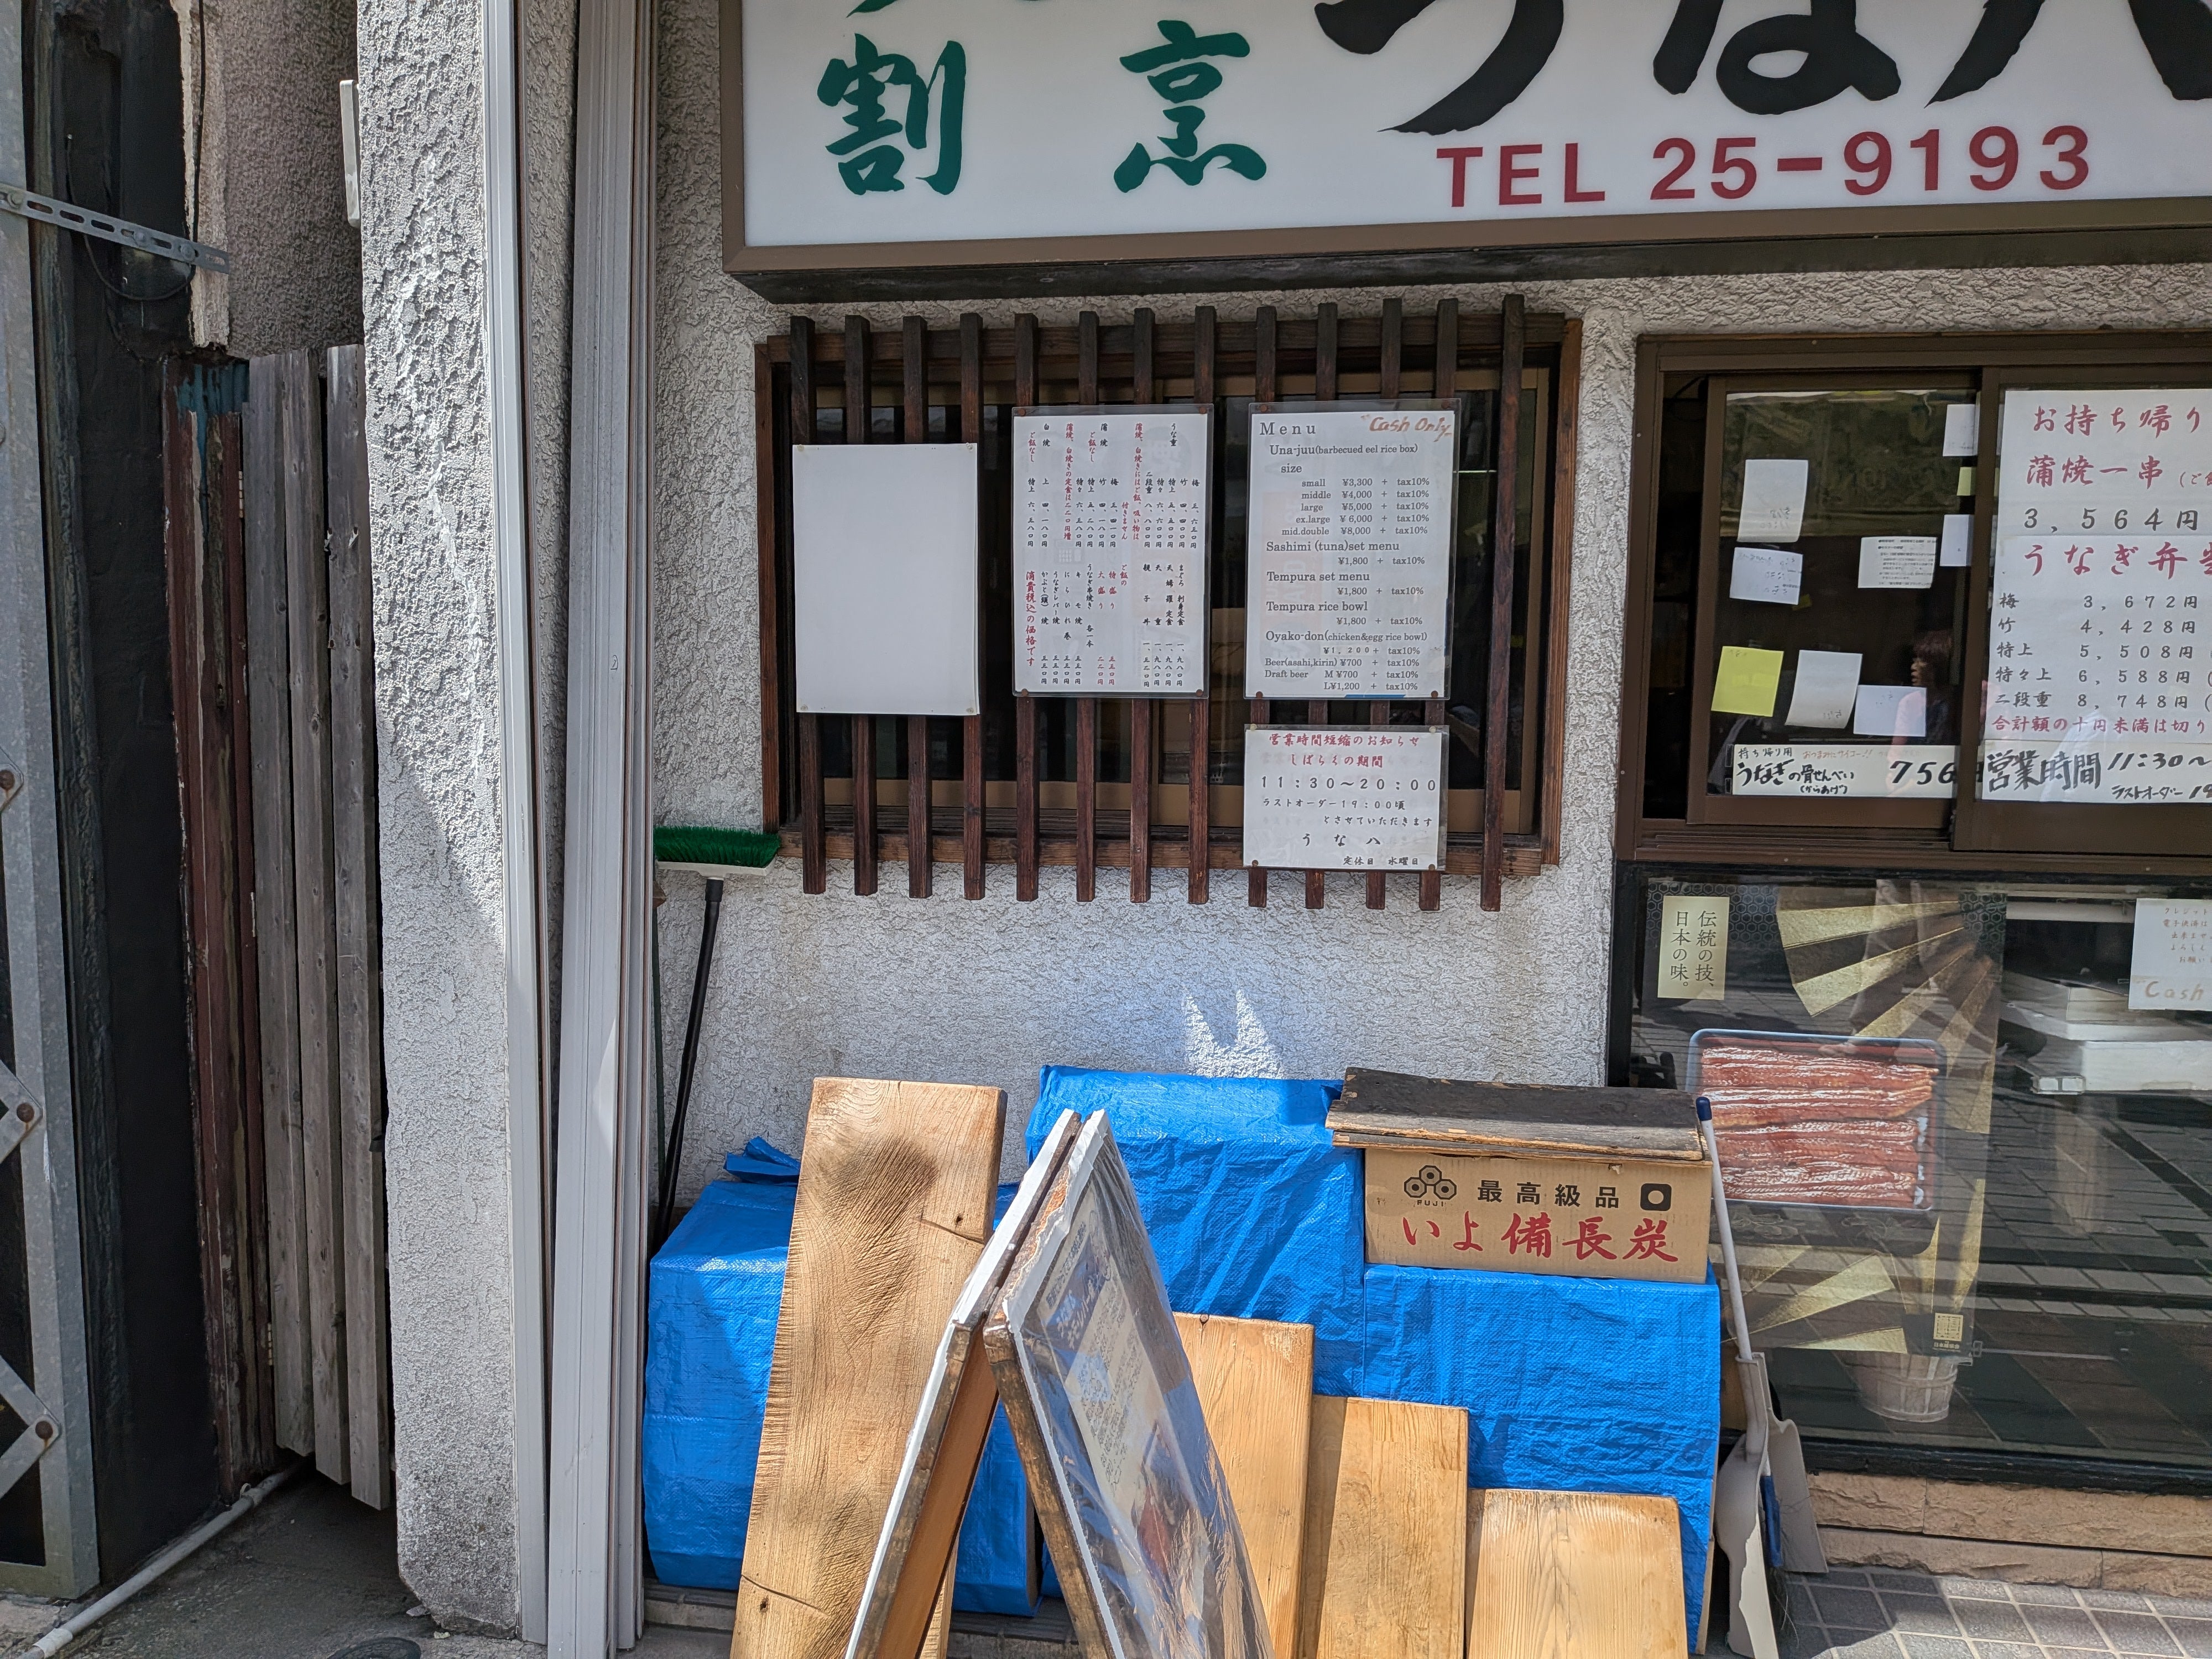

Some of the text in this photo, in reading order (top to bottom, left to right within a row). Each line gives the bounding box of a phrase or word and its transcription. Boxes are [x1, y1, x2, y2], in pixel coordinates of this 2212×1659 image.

[1436, 125, 2090, 208] TEL 25-9193
[2033, 404, 2200, 439] お持ち帰り
[1042, 423, 1051, 447] 白焼
[1169, 423, 1178, 447] うな重
[1259, 422, 1316, 435] Menu
[1365, 445, 1378, 453] eel
[1380, 445, 1397, 453] rice
[1281, 462, 1302, 473] size
[2027, 454, 2163, 489] 蒲焼一串
[1027, 477, 1036, 493] 特上
[1087, 477, 1095, 493] 特上
[1099, 477, 1107, 486] 竹
[1110, 478, 1119, 486] 梅
[1145, 471, 1153, 494] 二段重
[1168, 477, 1176, 493] 特上
[1180, 478, 1188, 487] 竹
[1191, 478, 1201, 487] 梅
[1301, 478, 1326, 487] small
[1397, 477, 1430, 486] tax10%
[1301, 491, 1332, 499] middle
[1301, 503, 1323, 513] large
[1396, 502, 1429, 510] tax10%
[1296, 514, 1430, 525] ex.large tax10%
[2024, 508, 2198, 533] 3,564円
[1281, 526, 1329, 535] mid.double
[1395, 526, 1428, 534] tax10%
[1266, 541, 1312, 551] Sashimi
[1392, 556, 1425, 565] tax10%
[1119, 564, 1129, 586] ご飯の
[1266, 571, 1316, 583] Tempura
[1319, 572, 1336, 581] set
[1391, 587, 1424, 595] tax10%
[1266, 601, 1368, 613] Tempura rice bowl
[1999, 592, 2020, 609] 梅
[1025, 570, 1037, 667] 消費税込の価格です
[1390, 617, 1423, 625] tax10%
[1997, 617, 2016, 634] 竹
[1385, 632, 1402, 641] rice
[1388, 646, 1421, 655] tax10%
[1996, 641, 2033, 658] 特上
[1387, 659, 1420, 667] tax10%
[1264, 669, 1288, 678] Draft
[1290, 670, 1309, 678] beer
[1324, 670, 1334, 678] M
[1386, 670, 1418, 679] tax10%
[1995, 666, 2052, 683] 特々上
[1995, 691, 2052, 708] 二段重
[1269, 732, 1421, 747] 営業時間短縮のお知らせ
[1738, 747, 1792, 759] 持ち帰り用
[1291, 754, 1383, 768] しばらくの期間
[1736, 758, 1855, 787] うなぎの骨せんべい
[1987, 749, 2101, 792] 営業時間
[1324, 815, 1432, 827] とさせていただきます
[1302, 833, 1381, 847] うな八
[1343, 855, 1418, 866] 定休日 水曜日
[2146, 981, 2204, 1001] Cash
[1477, 1180, 1619, 1209] 最高級品
[1402, 1210, 1679, 1262] いよ備長炭
